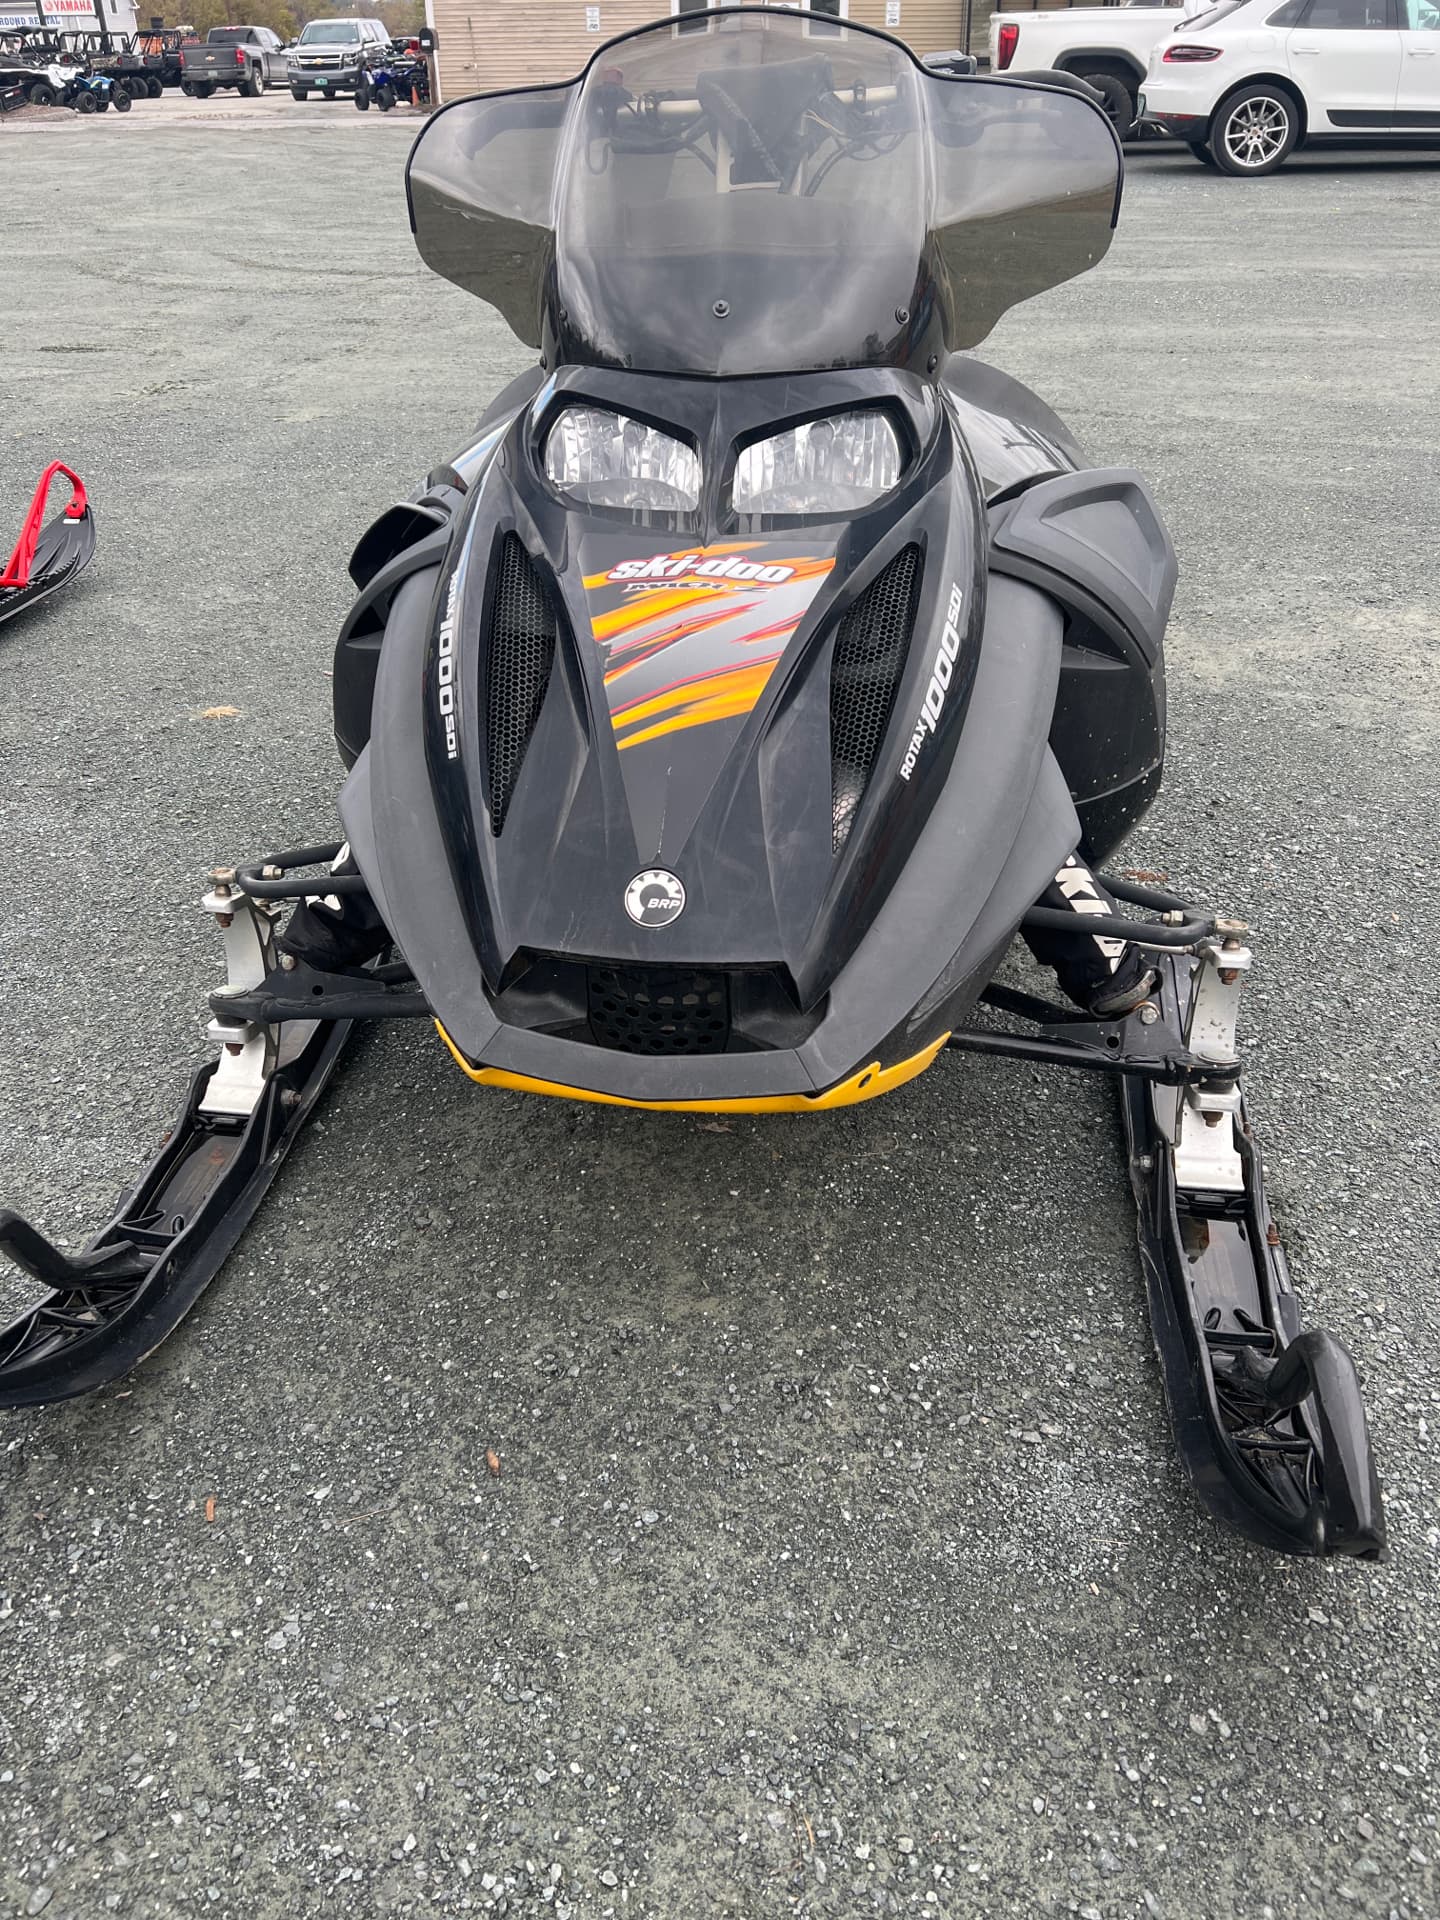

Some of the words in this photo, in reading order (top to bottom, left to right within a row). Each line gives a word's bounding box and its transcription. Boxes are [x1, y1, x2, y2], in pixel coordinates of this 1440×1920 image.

[54, 0, 93, 11] YAMAHA
[29, 16, 61, 25] RETAL
[607, 553, 797, 584] ski-doo
[438, 616, 454, 716] 1000
[900, 718, 928, 781] ROTAX
[920, 620, 961, 734] 1000
[647, 898, 681, 909] BRP
